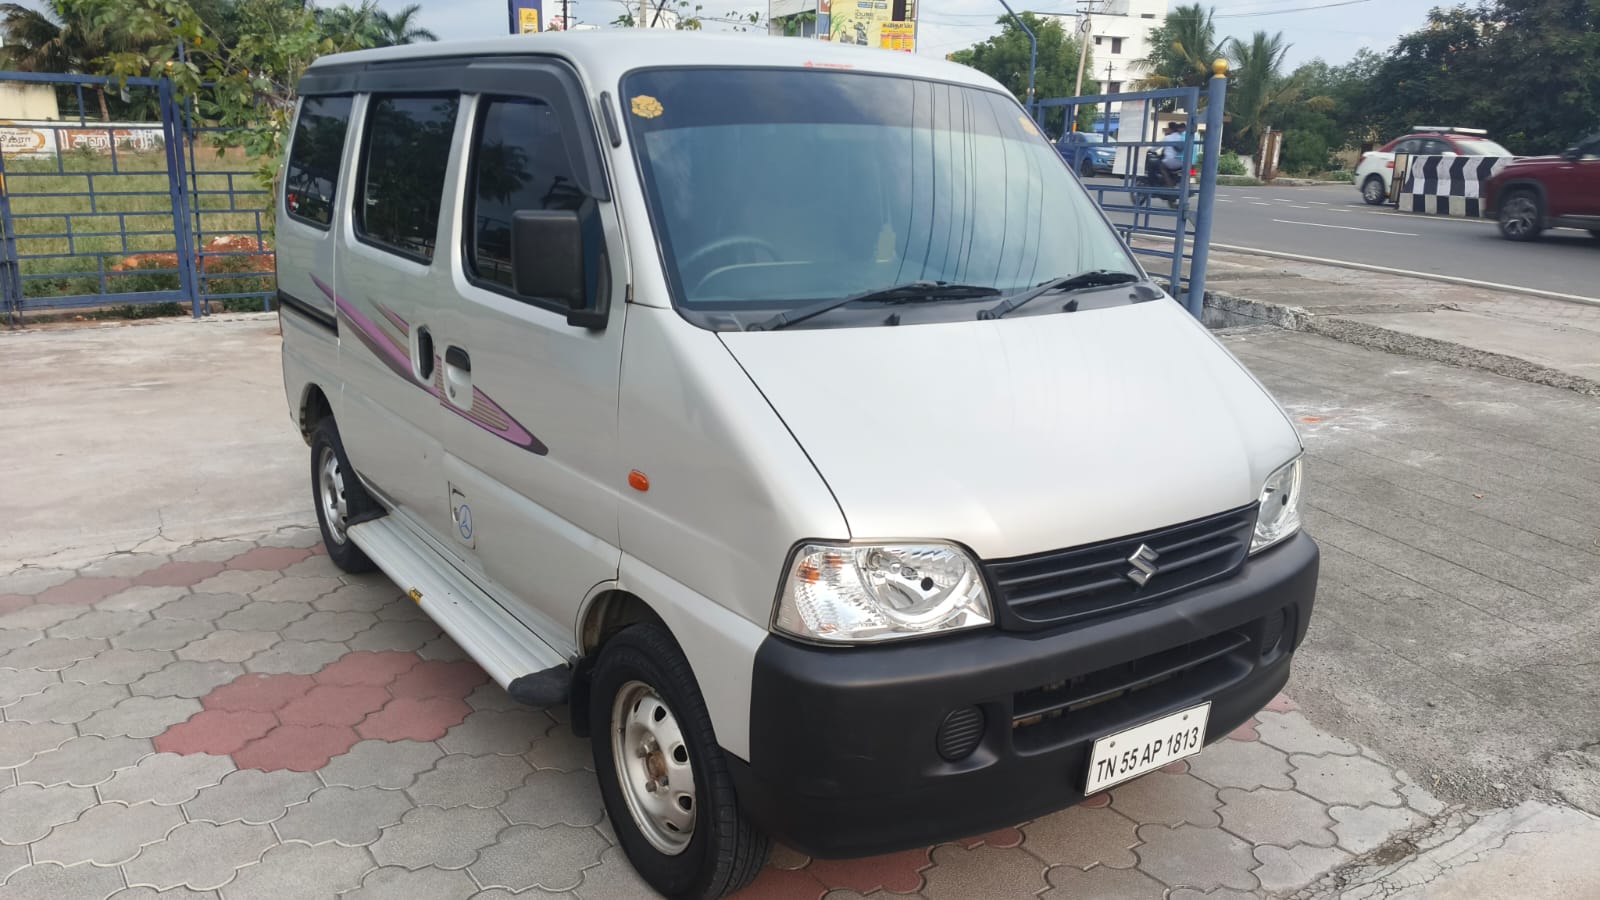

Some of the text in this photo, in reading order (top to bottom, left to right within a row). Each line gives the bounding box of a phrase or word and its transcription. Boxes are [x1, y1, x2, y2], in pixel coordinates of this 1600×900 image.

[1097, 726, 1199, 783] TN 55 AP 1813
